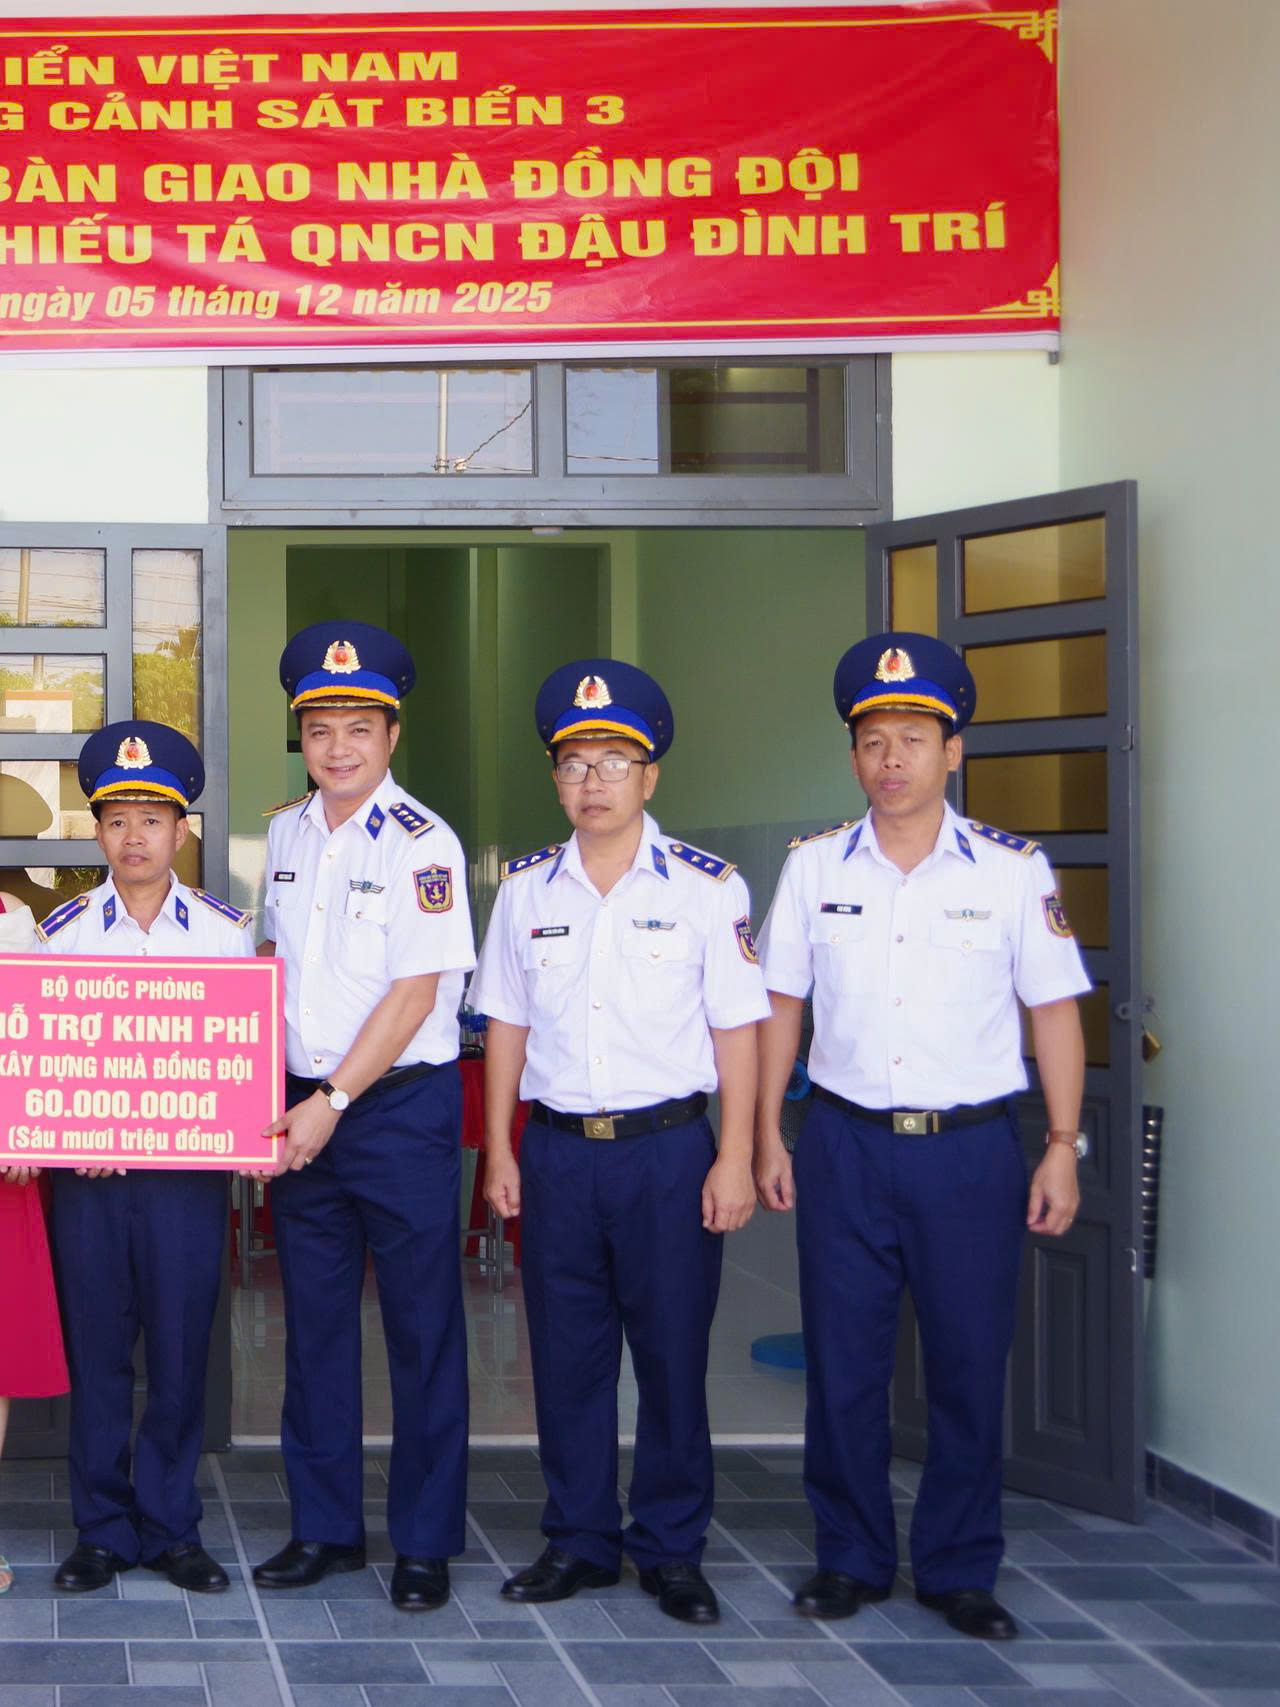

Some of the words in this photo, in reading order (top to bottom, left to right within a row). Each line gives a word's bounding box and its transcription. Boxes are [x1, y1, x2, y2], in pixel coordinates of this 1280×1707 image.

[136, 47, 279, 91] VIỆT
[301, 50, 458, 83] NAM
[48, 90, 234, 131] CẢNH
[256, 91, 384, 130] SÁT
[405, 83, 564, 127] BIỂN
[585, 94, 626, 126] 3
[142, 162, 312, 204] GIAO
[336, 152, 490, 202] NHÀ
[509, 145, 713, 200] ĐỒNG
[734, 147, 860, 201] ĐỘI
[175, 215, 267, 266] TÁ
[289, 221, 495, 268] QNCN
[516, 212, 667, 268] ĐẬU
[689, 207, 867, 258] ĐÌNH
[889, 201, 1007, 253] TRÍ
[103, 283, 158, 318] 05
[166, 282, 281, 322] tháng
[293, 281, 345, 318] 12
[350, 278, 442, 317] năm
[449, 278, 555, 317] 2025
[40, 974, 69, 1003] BỘ
[74, 972, 130, 1001] QUỐC
[135, 976, 206, 1001] PHÒNG
[39, 1011, 104, 1048] TRỢ
[112, 1015, 193, 1043] KINH
[203, 1010, 260, 1044] PHÍ
[39, 1053, 98, 1083] DỰNG
[103, 1052, 148, 1080] NHÀ
[152, 1050, 212, 1081] ĐỒNG
[216, 1053, 254, 1086] ĐỘI
[24, 1087, 218, 1120] 60.000.000đ
[7, 1124, 56, 1151] (Sáu
[61, 1127, 115, 1150] mươi
[119, 1127, 170, 1156] triệu
[175, 1125, 235, 1155] đồng)
